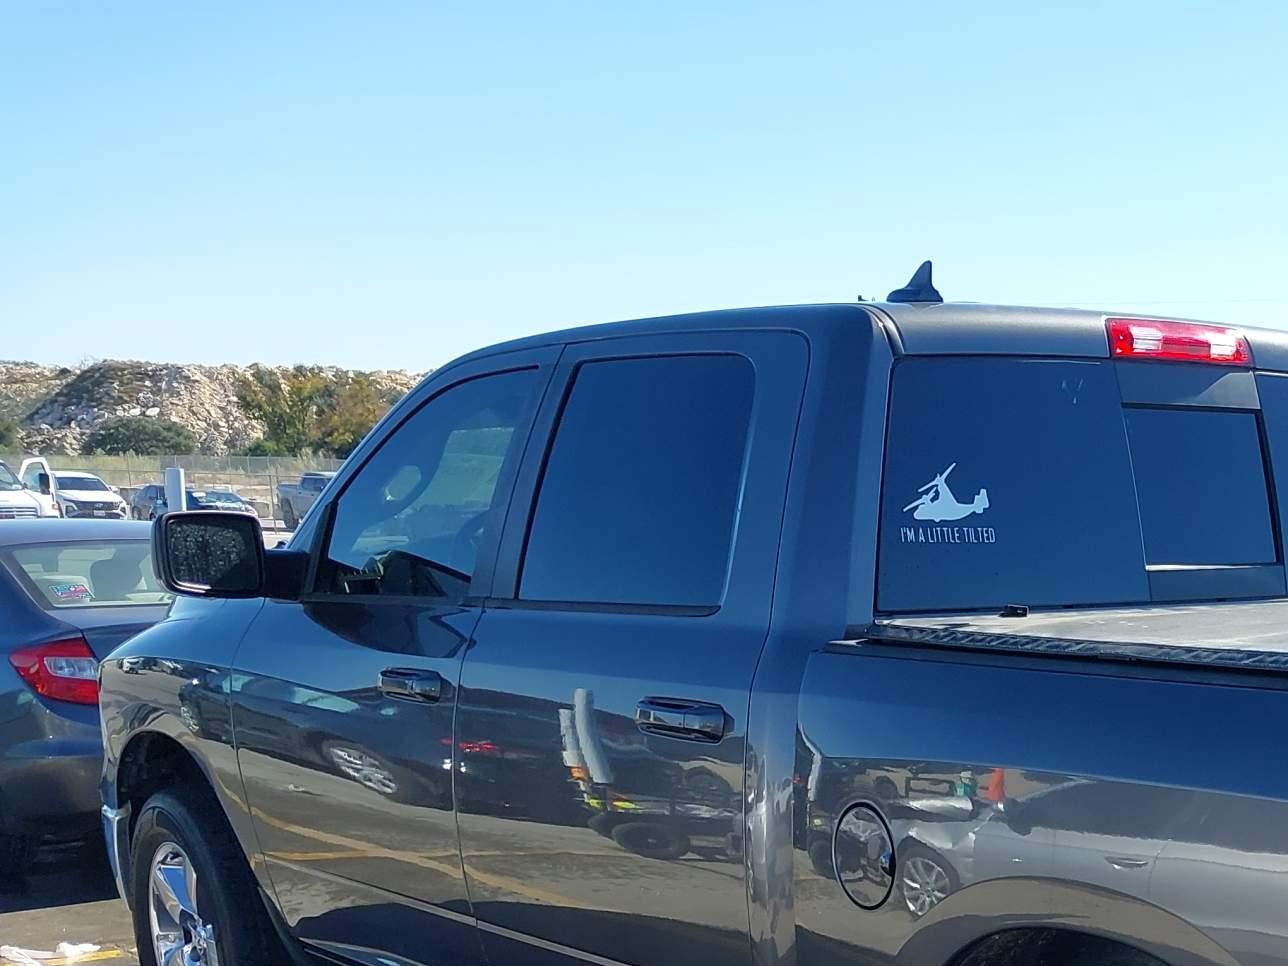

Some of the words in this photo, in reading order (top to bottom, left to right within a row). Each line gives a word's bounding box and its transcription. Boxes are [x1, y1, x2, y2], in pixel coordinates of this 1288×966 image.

[900, 527, 916, 543] I'M
[919, 527, 926, 543] A
[927, 527, 961, 543] LITTLE
[962, 527, 996, 543] TILTED
